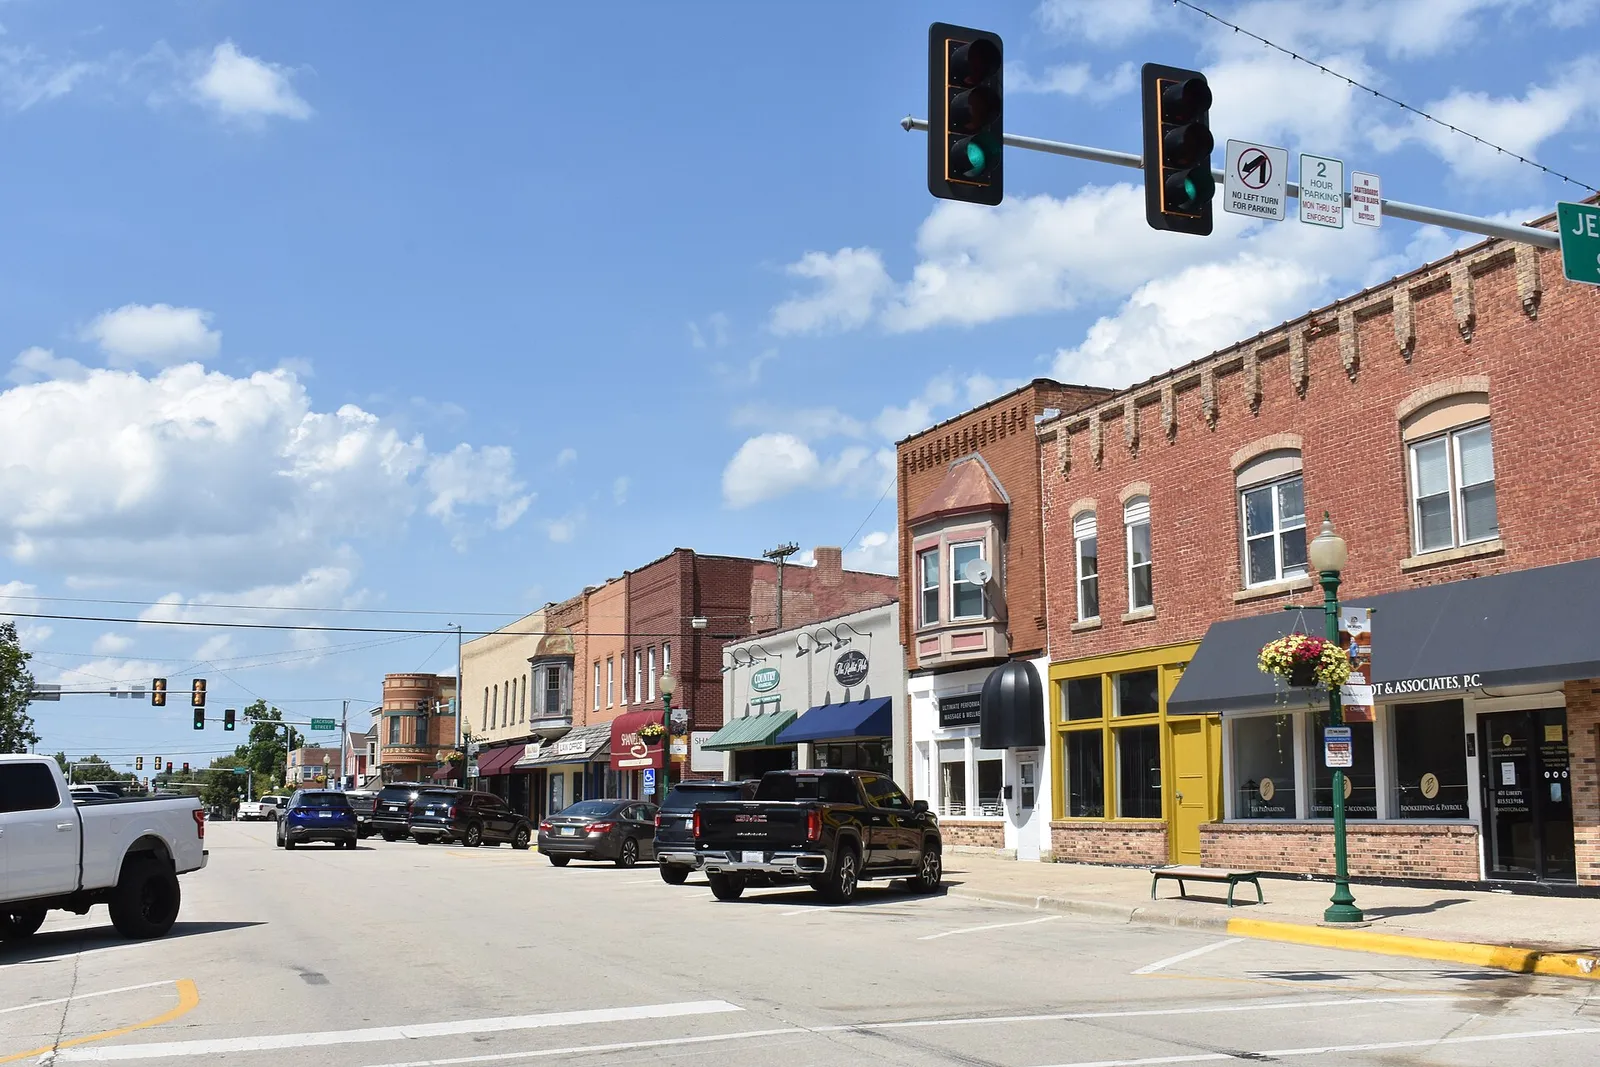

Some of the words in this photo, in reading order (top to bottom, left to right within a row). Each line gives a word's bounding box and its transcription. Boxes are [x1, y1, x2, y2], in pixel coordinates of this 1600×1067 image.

[1317, 162, 1326, 178] 2
[1310, 179, 1333, 190] HOUR
[1232, 191, 1242, 199] NO
[1243, 193, 1259, 202] LEFT
[1260, 196, 1279, 205] TURN
[1304, 189, 1339, 203] PARKING
[1233, 201, 1247, 210] FOR
[1247, 203, 1277, 215] PARKING
[1302, 200, 1314, 210] MON
[1316, 203, 1330, 213] THRU
[1331, 206, 1341, 214] SAT
[1307, 212, 1337, 224] ENFORCED
[754, 670, 776, 684] COUNTRY
[1385, 682, 1393, 695] &
[1395, 675, 1461, 694] ASSOCIATES,
[1463, 674, 1483, 688] P.C.
[944, 712, 961, 720] MASSAGE
[560, 743, 570, 751] LAW
[570, 741, 583, 750] OFFICE
[1400, 803, 1434, 812] BOOKKEEPING
[1435, 803, 1441, 811] &
[1441, 803, 1464, 811] PAYROLL
[735, 814, 767, 822] GMC
